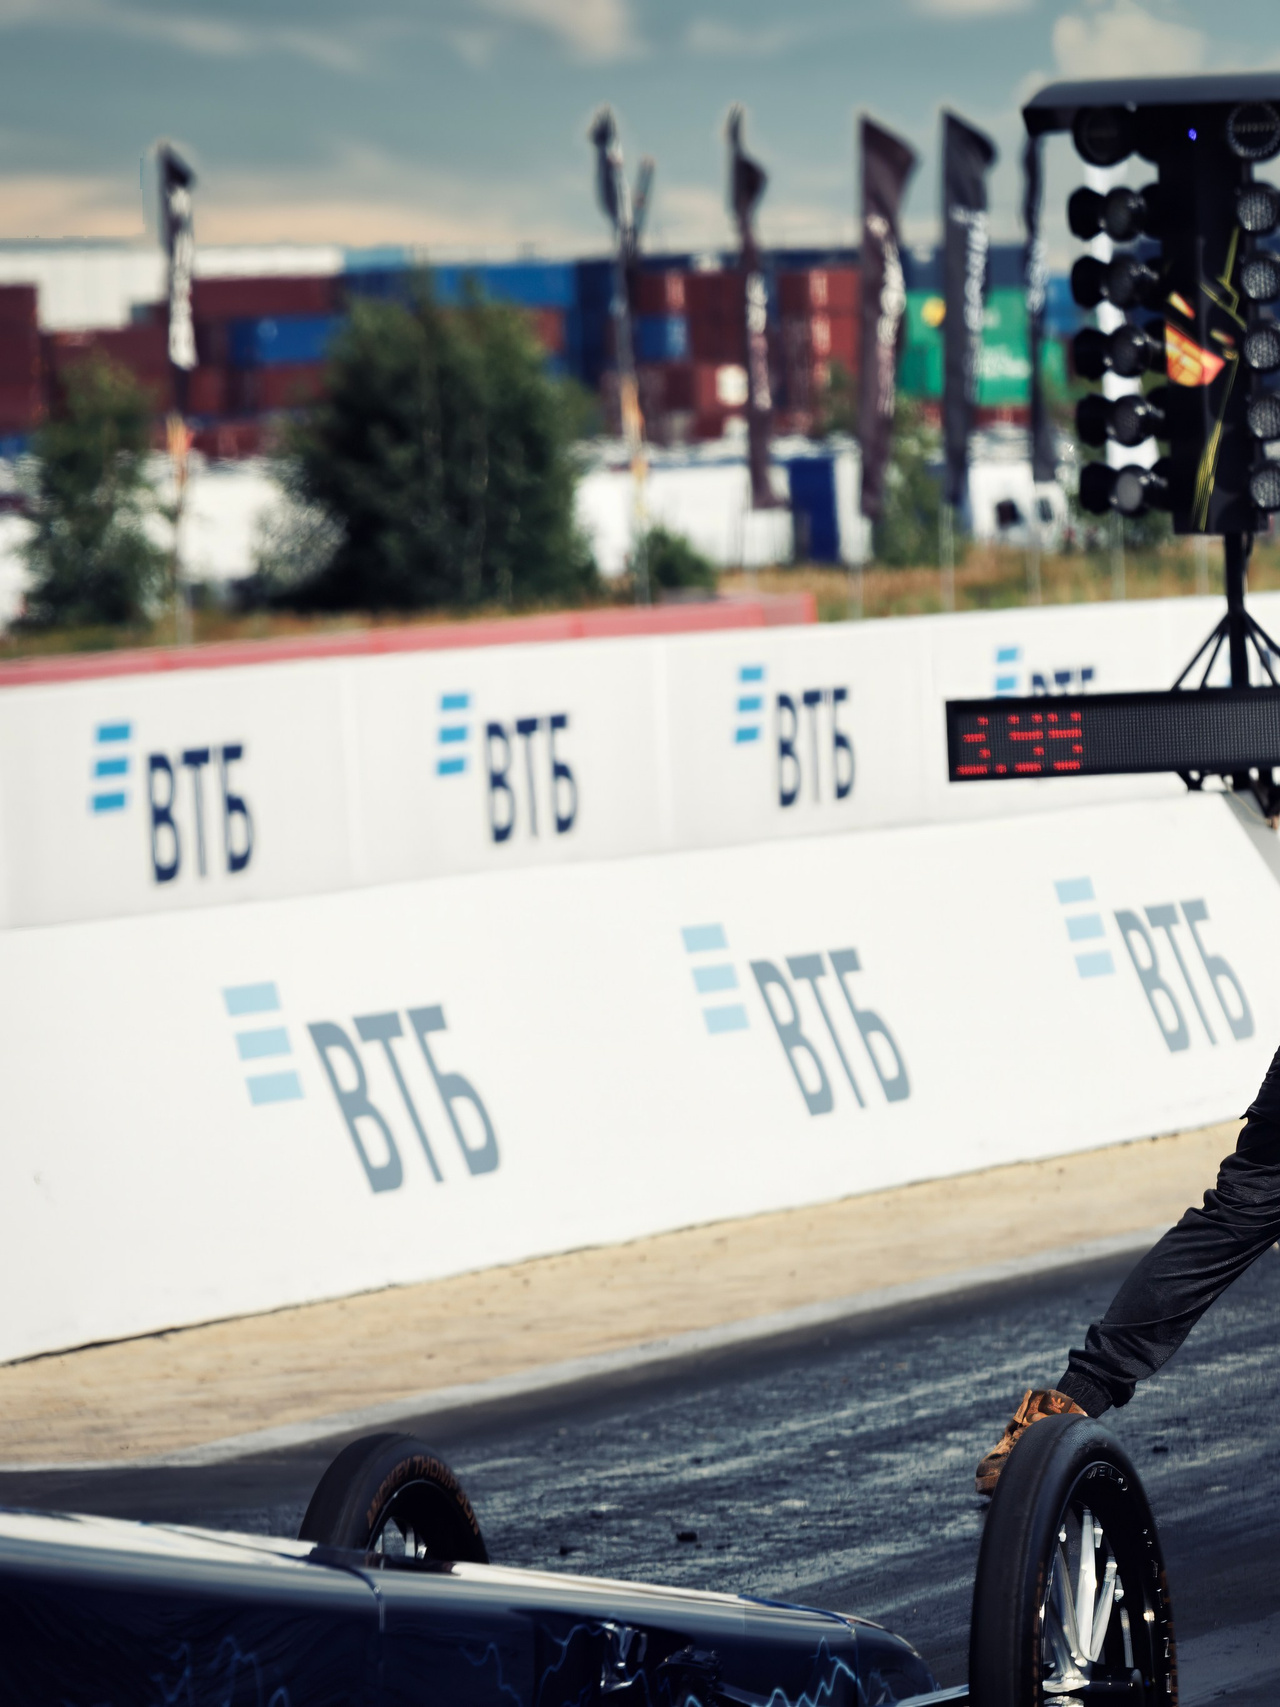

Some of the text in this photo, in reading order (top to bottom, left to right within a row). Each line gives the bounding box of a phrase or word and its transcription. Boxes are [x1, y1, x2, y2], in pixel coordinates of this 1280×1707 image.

[147, 743, 254, 884] ВТБ
[485, 713, 578, 844] ВТБ
[776, 686, 856, 808] ВТБ
[749, 947, 911, 1117] ВТБ
[1113, 898, 1255, 1053] ВТБ
[306, 1004, 500, 1195] ВТБ
